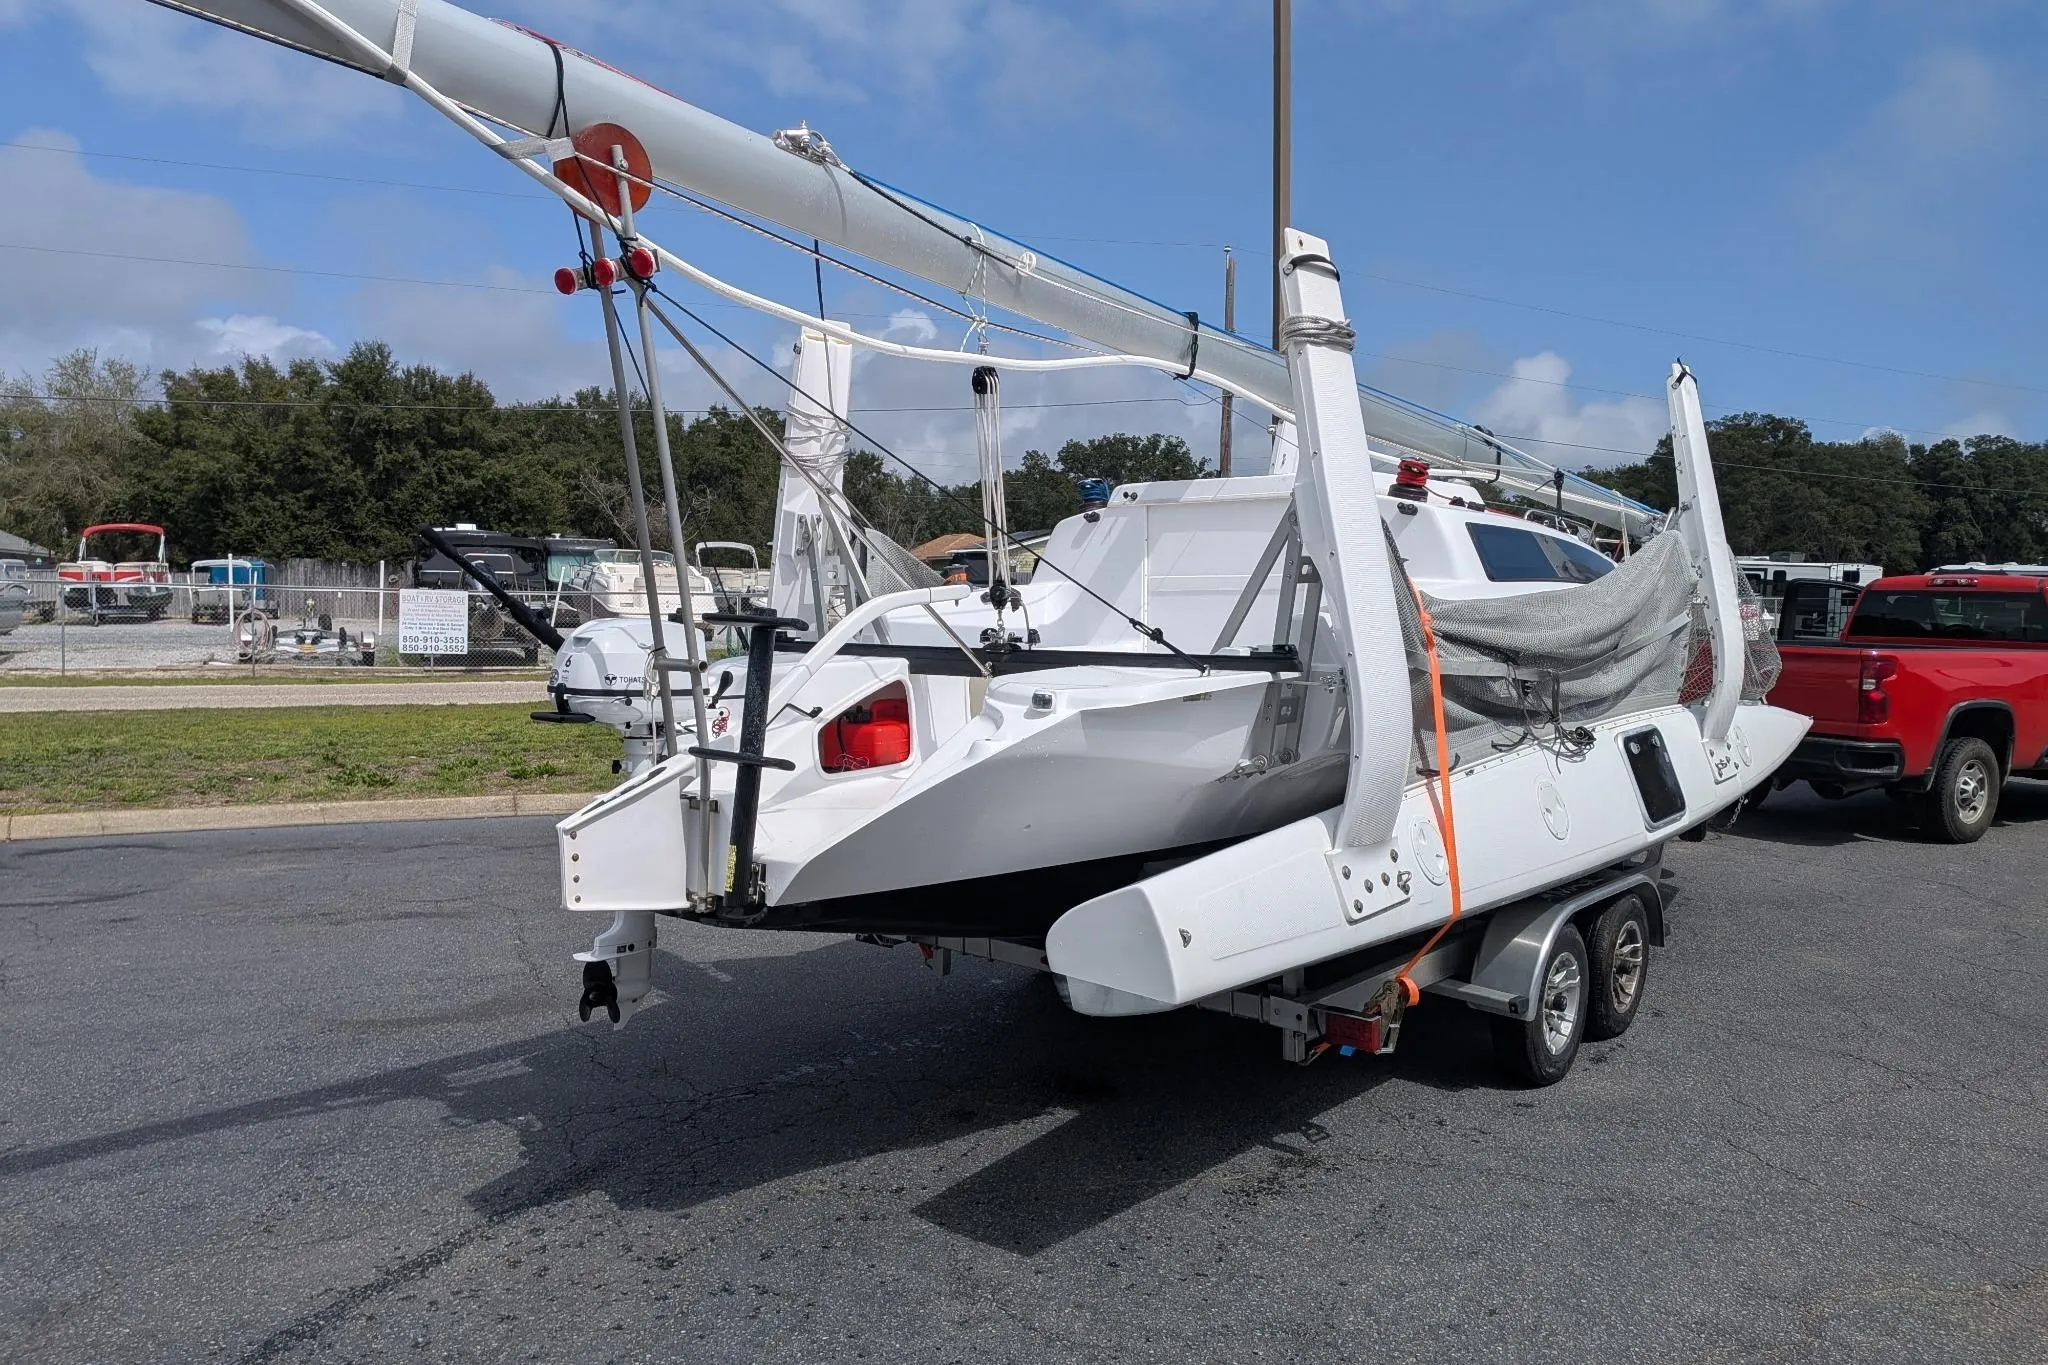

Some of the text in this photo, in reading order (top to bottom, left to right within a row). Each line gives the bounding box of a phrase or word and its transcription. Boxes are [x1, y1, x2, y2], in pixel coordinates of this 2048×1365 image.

[435, 596, 465, 604] STORAGE
[402, 635, 465, 644] 850-910-3553
[402, 644, 465, 653] 850-910-3552
[619, 676, 645, 684] TOHATS
